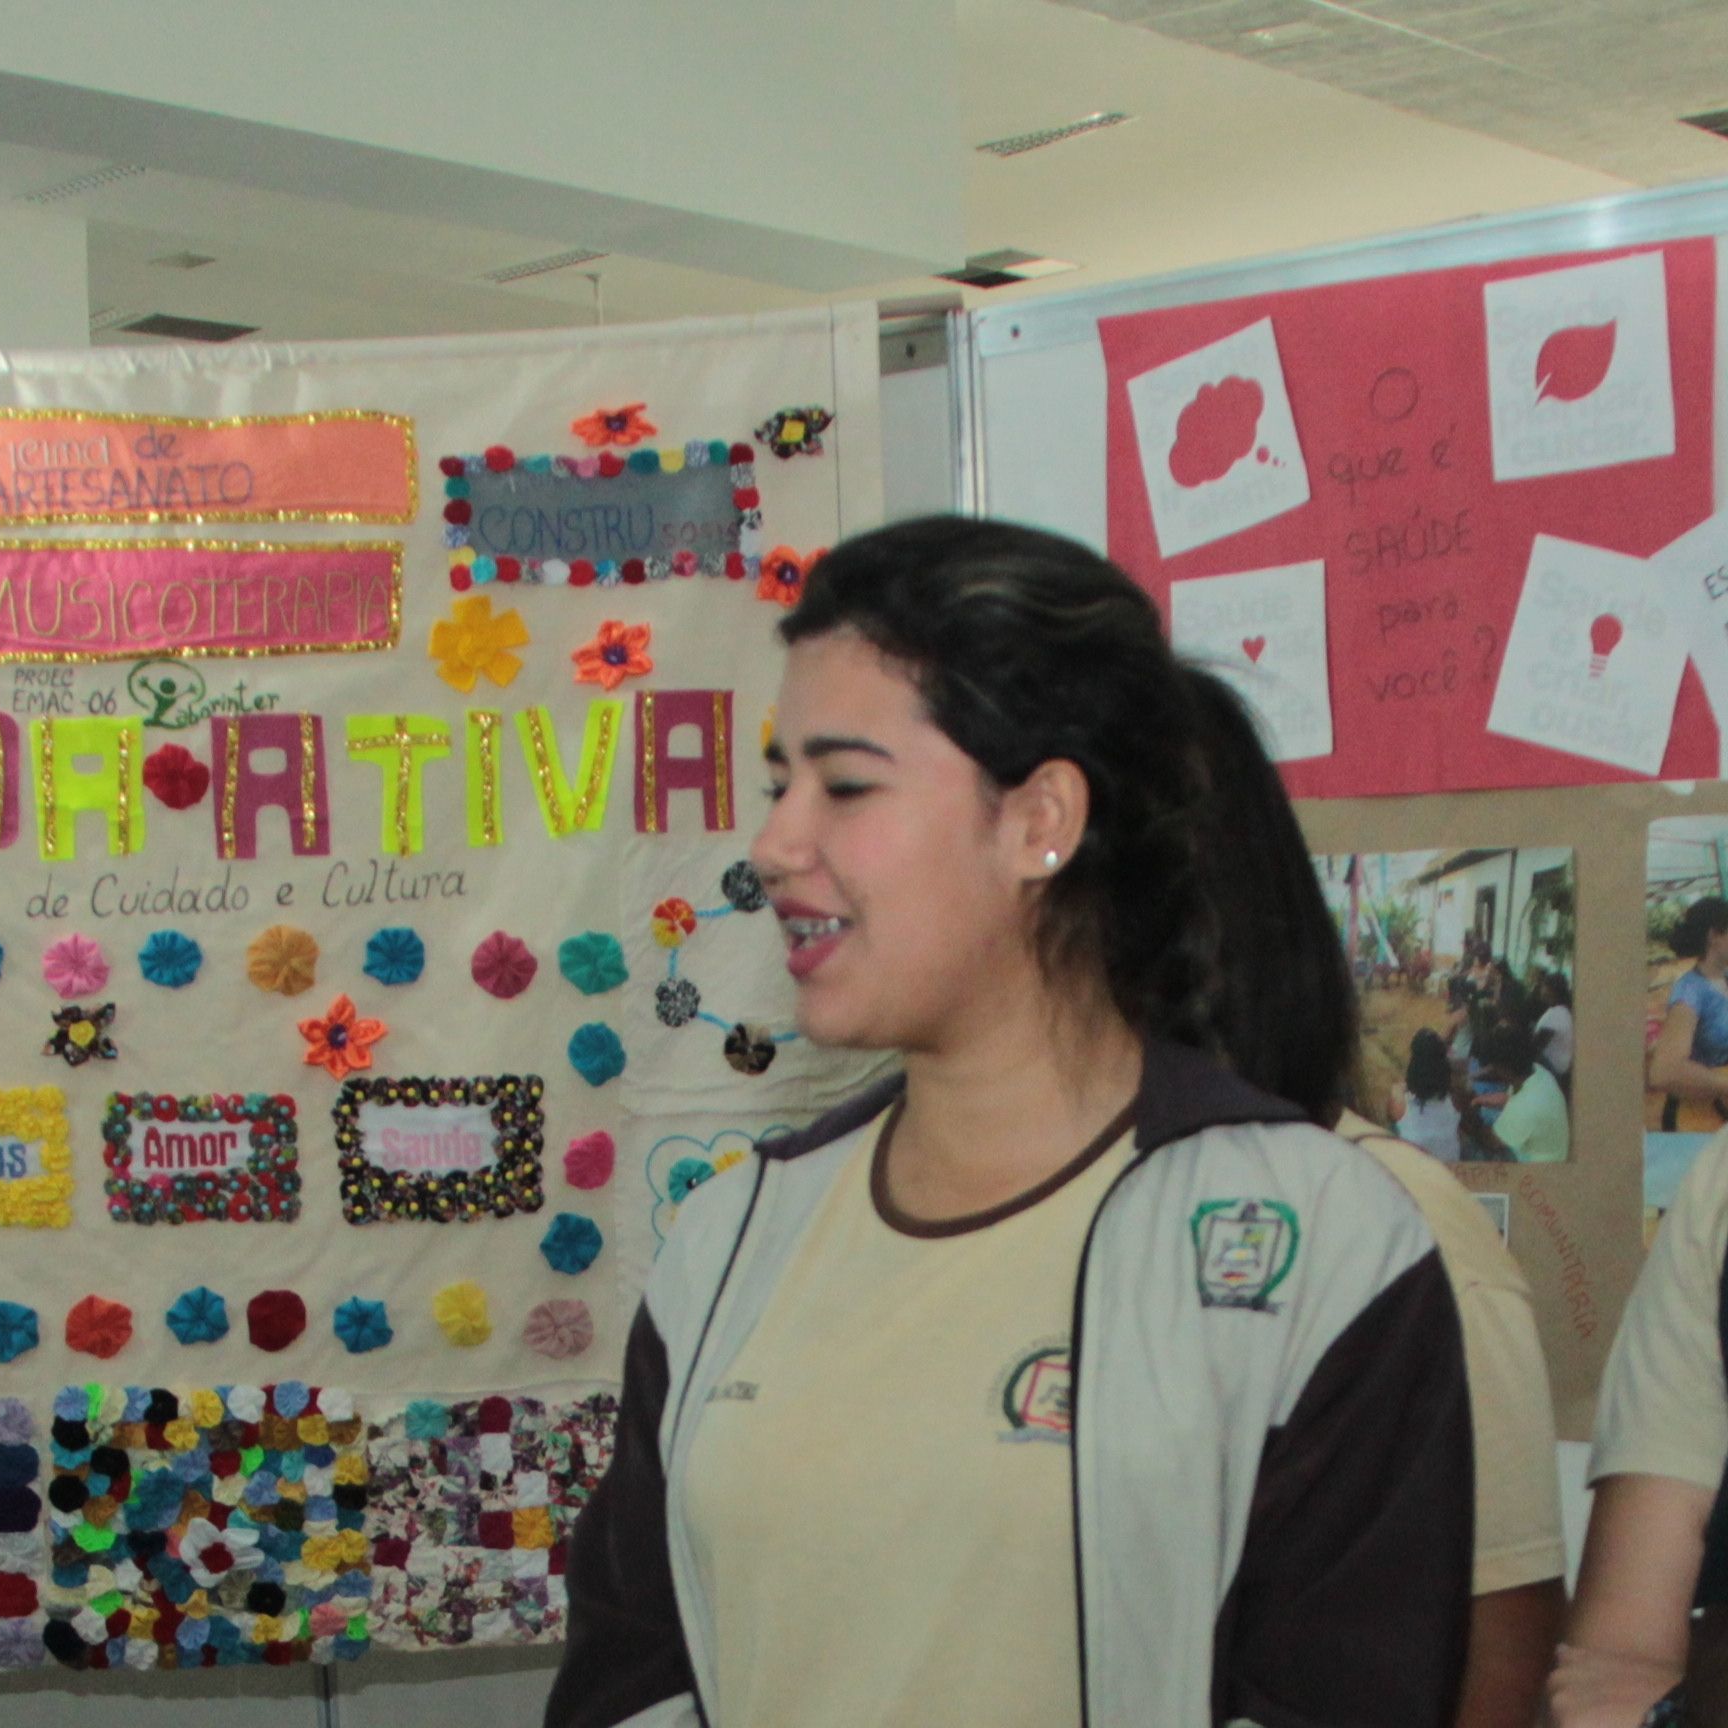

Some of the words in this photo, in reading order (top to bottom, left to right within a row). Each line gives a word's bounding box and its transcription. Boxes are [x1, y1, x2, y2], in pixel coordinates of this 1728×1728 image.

[132, 424, 180, 460] de
[1328, 446, 1407, 505] que
[210, 689, 736, 861] ATIVA
[26, 874, 70, 919] de
[91, 864, 251, 917] Cuidado
[275, 880, 296, 907] e
[320, 859, 468, 909] Cultura
[142, 1127, 238, 1168] Amor
